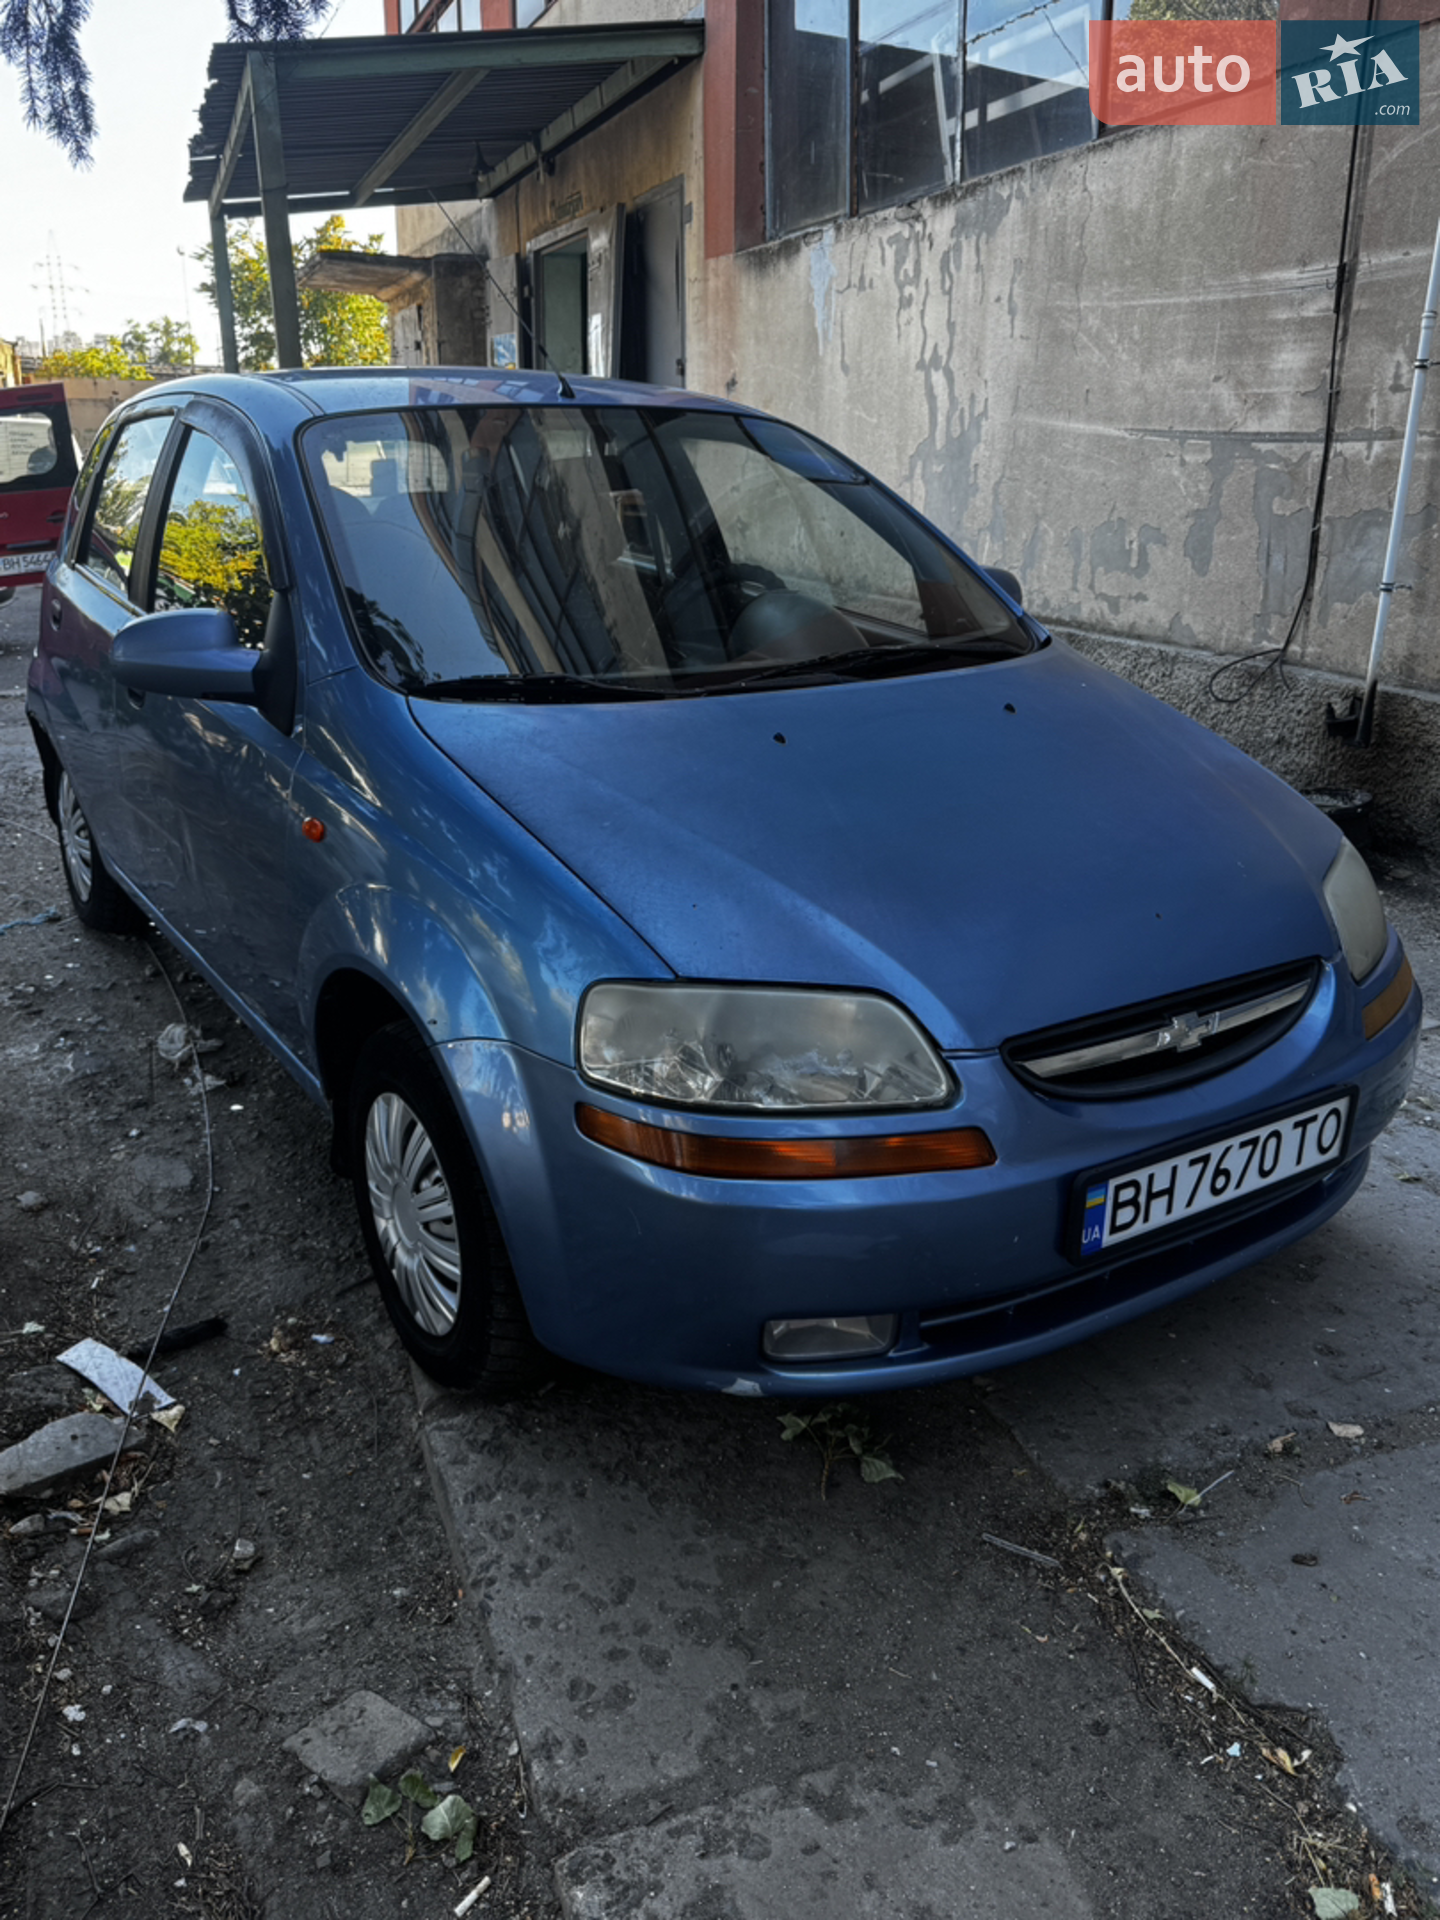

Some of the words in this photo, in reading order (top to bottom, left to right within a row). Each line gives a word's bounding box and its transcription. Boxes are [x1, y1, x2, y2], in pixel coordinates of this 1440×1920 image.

[1109, 1164, 1178, 1236] BH
[1185, 1129, 1282, 1208] 7670
[1082, 1225, 1100, 1243] UA
